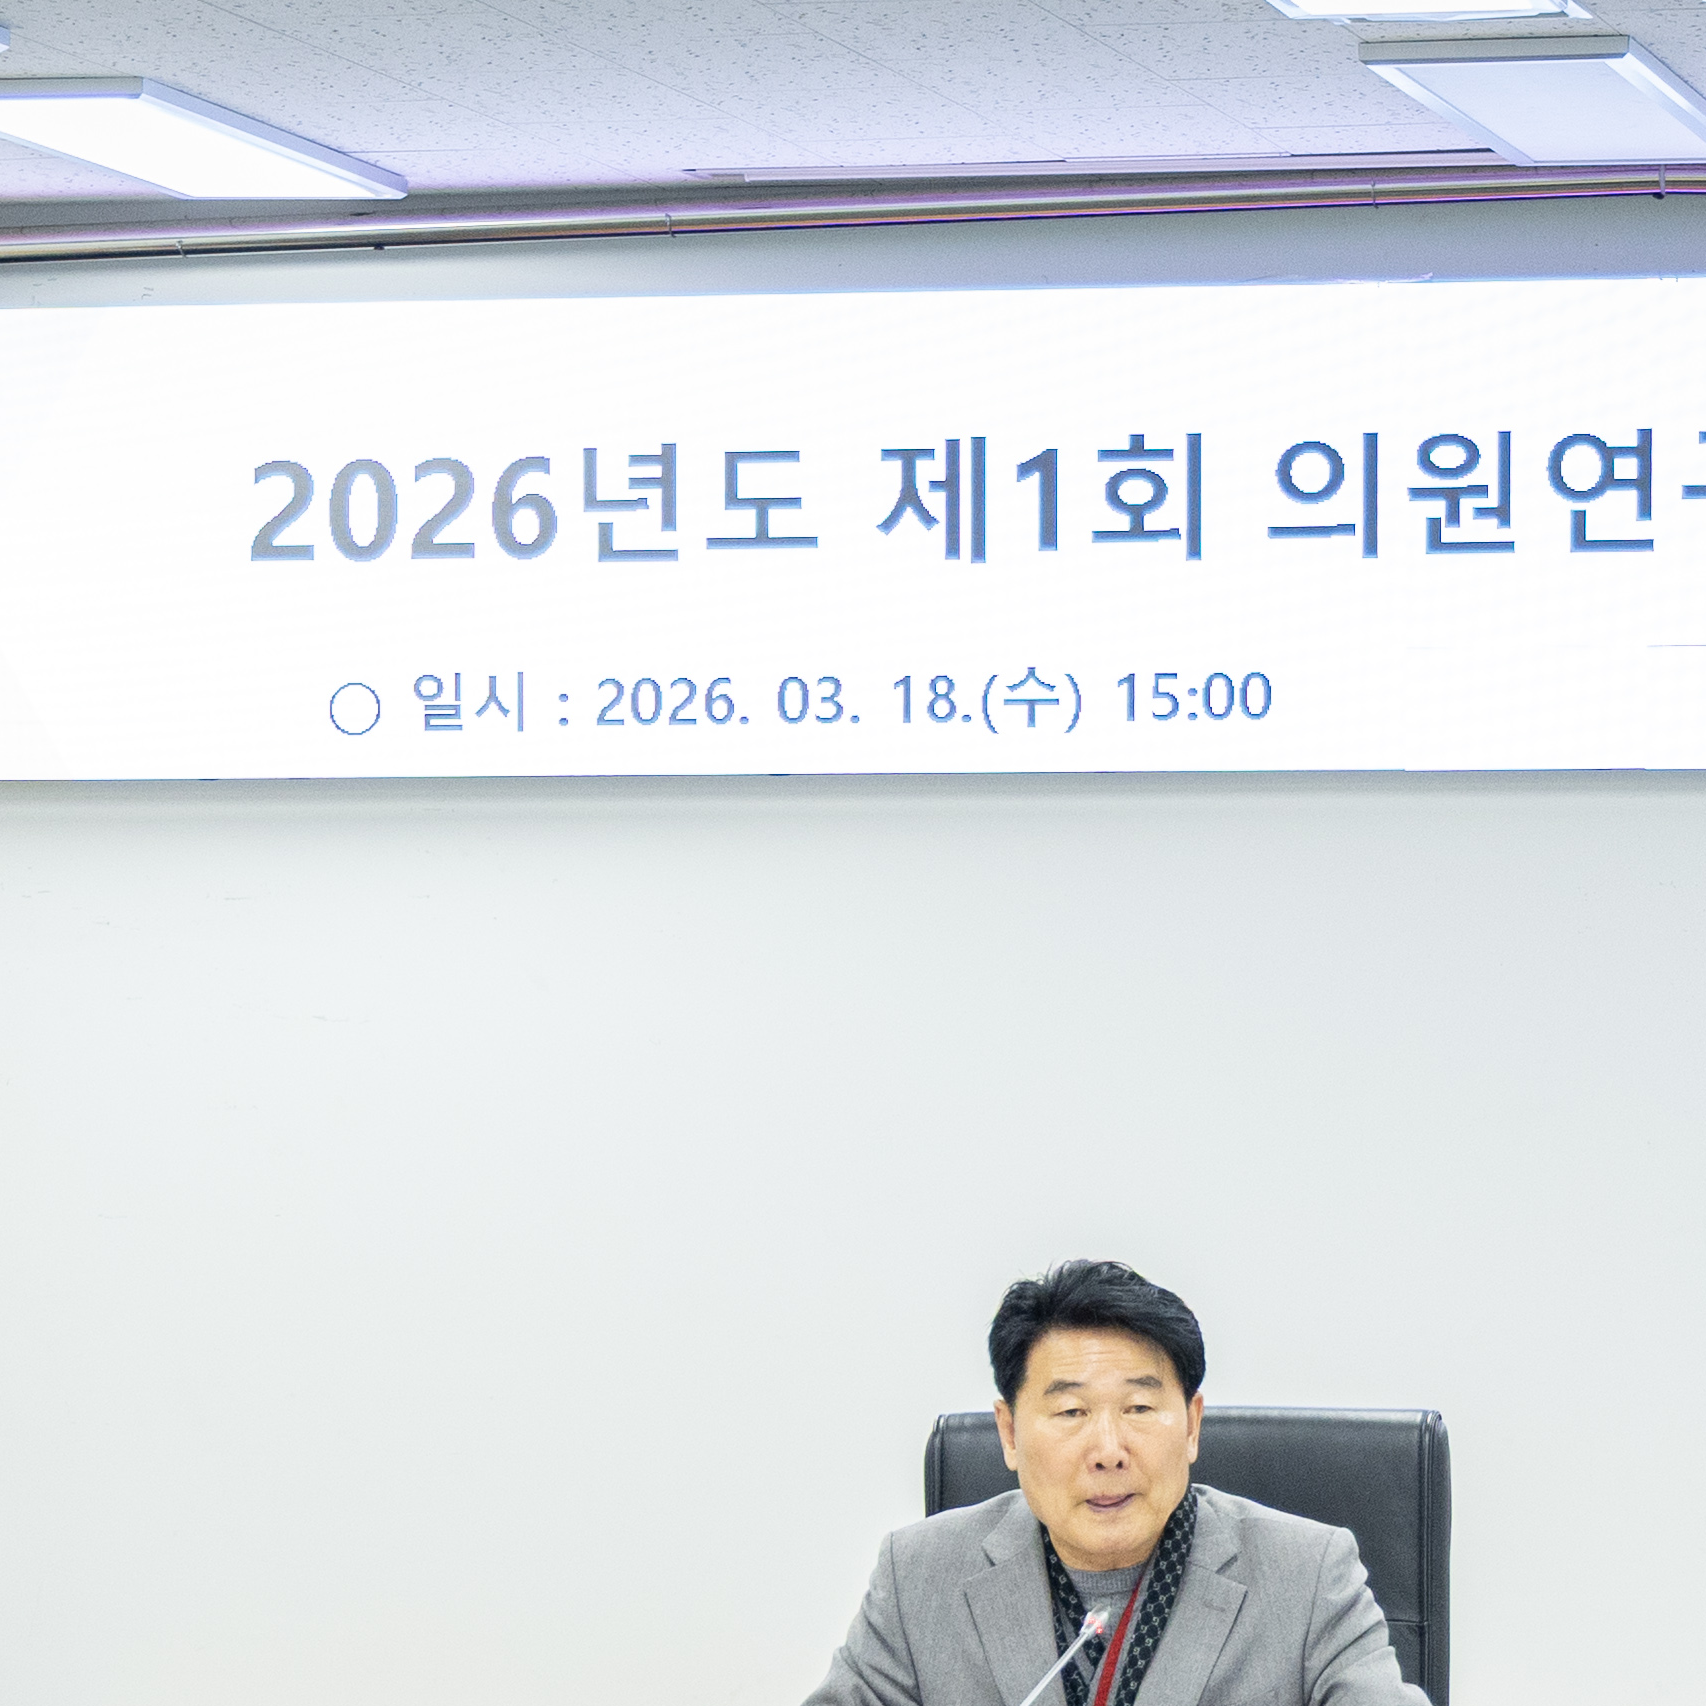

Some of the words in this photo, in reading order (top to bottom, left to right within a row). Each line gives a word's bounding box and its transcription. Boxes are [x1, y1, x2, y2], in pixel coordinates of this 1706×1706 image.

[250, 442, 819, 563] 2026년도
[875, 432, 1203, 564] 제1회
[413, 671, 524, 733] 일시
[596, 676, 750, 726] 2026.
[777, 675, 861, 725] 03.
[893, 666, 1082, 735] 18.(수)
[1117, 671, 1272, 722] 15:00
